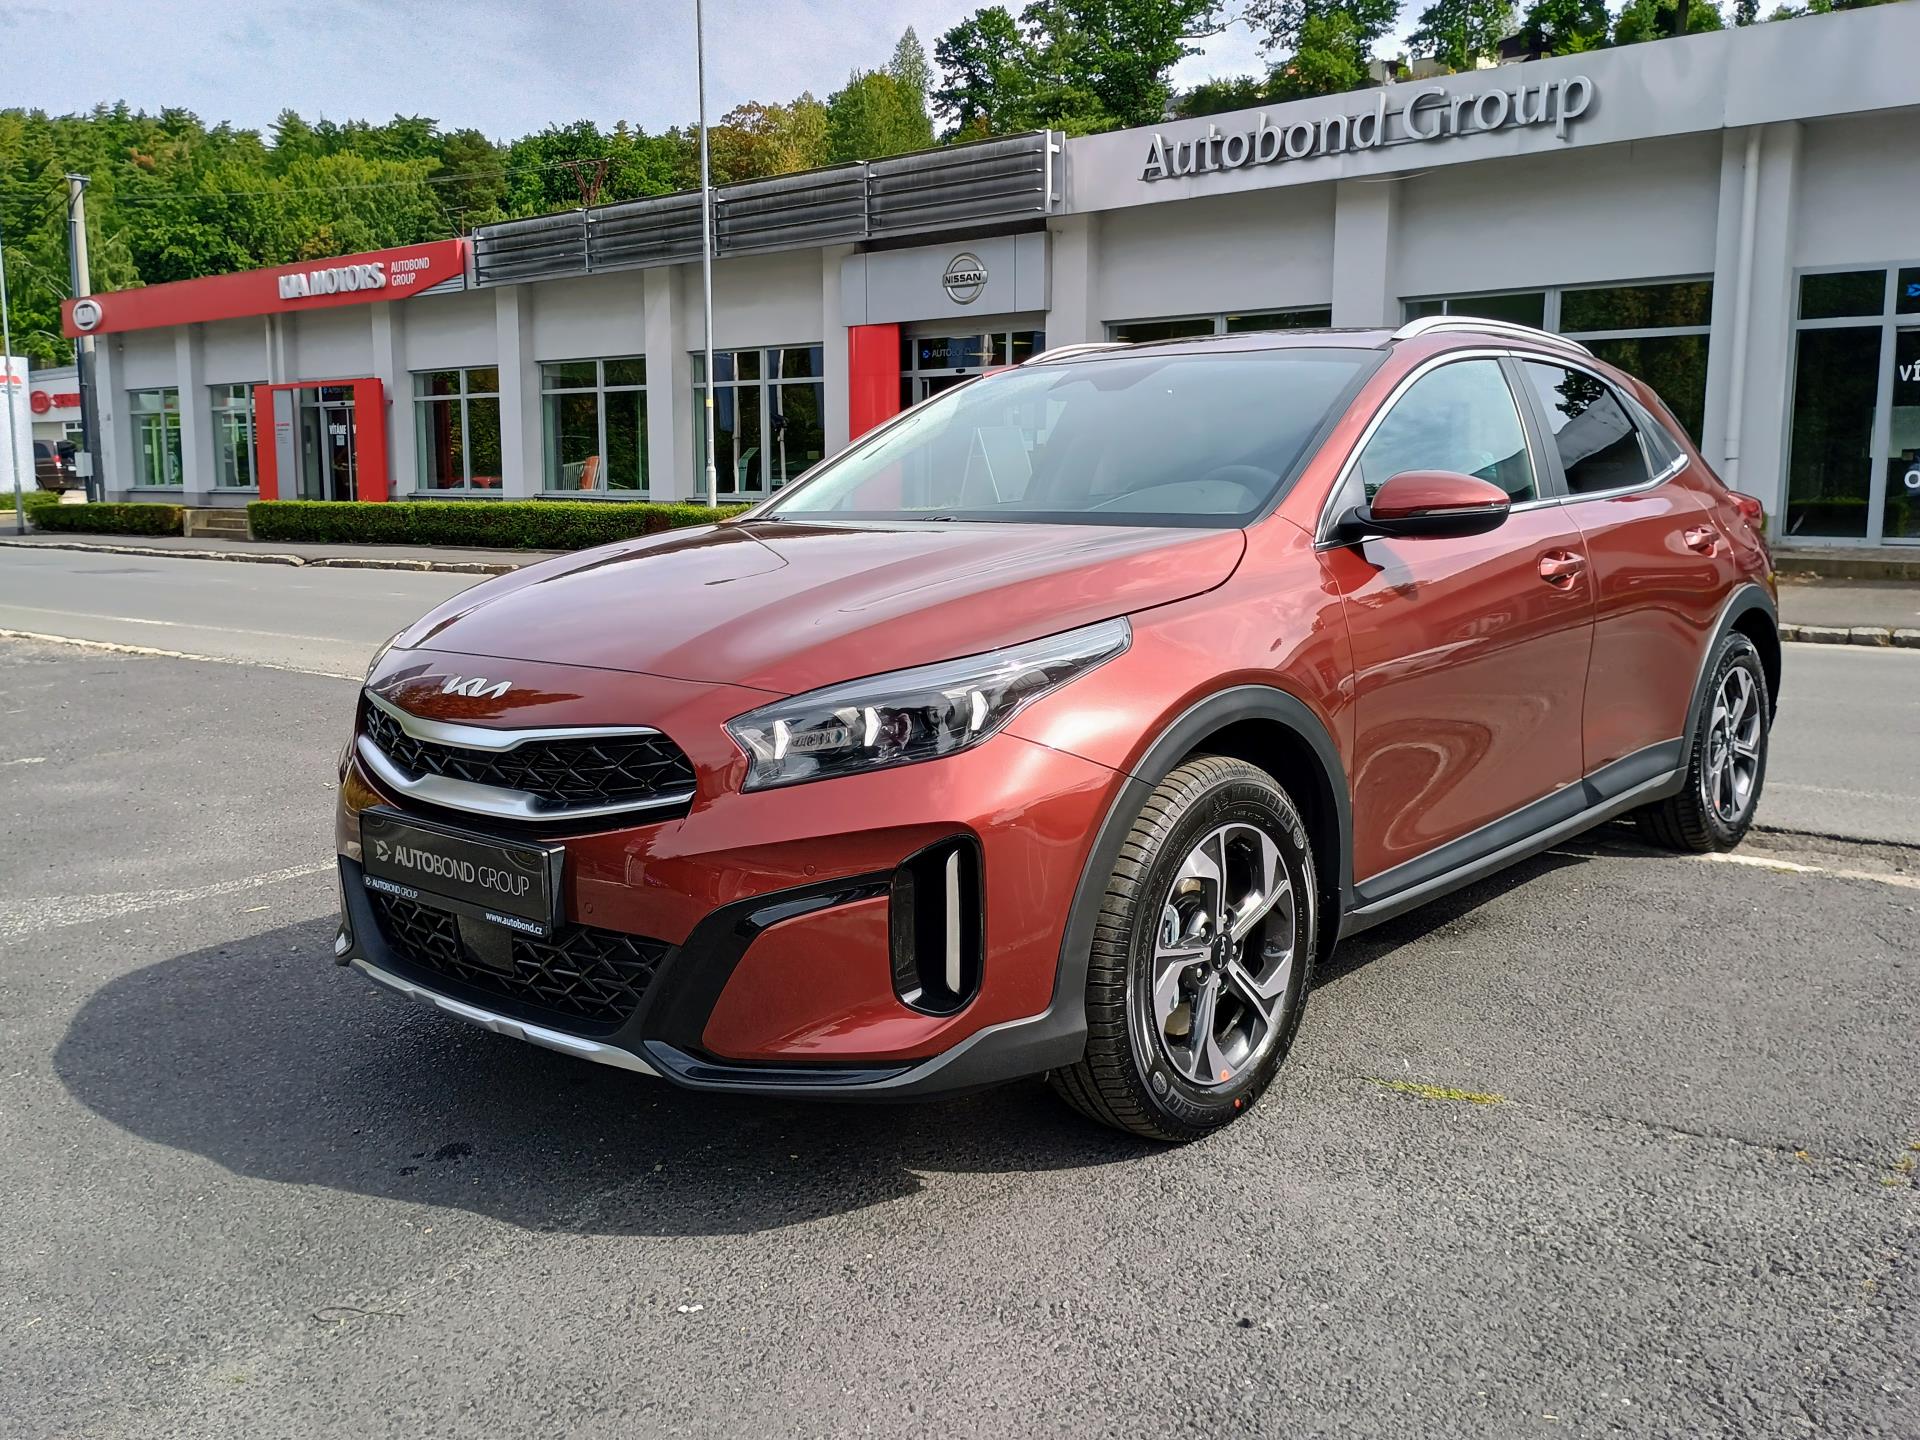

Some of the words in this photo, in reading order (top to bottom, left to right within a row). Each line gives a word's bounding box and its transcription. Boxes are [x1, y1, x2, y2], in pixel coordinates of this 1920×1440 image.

[1138, 92, 1388, 181] Autobond
[1402, 75, 1596, 139] Group
[391, 257, 430, 273] AUTOBOND
[310, 262, 387, 295] MOTORS
[391, 273, 416, 287] GROUP
[944, 272, 981, 284] NISSAN
[442, 676, 513, 700] KIA
[394, 845, 475, 883] AUTOBOND
[478, 866, 530, 897] GROUP
[371, 878, 401, 894] AUTOBOND
[400, 886, 418, 899] GROUP
[485, 912, 543, 935] www.autobond.cz
